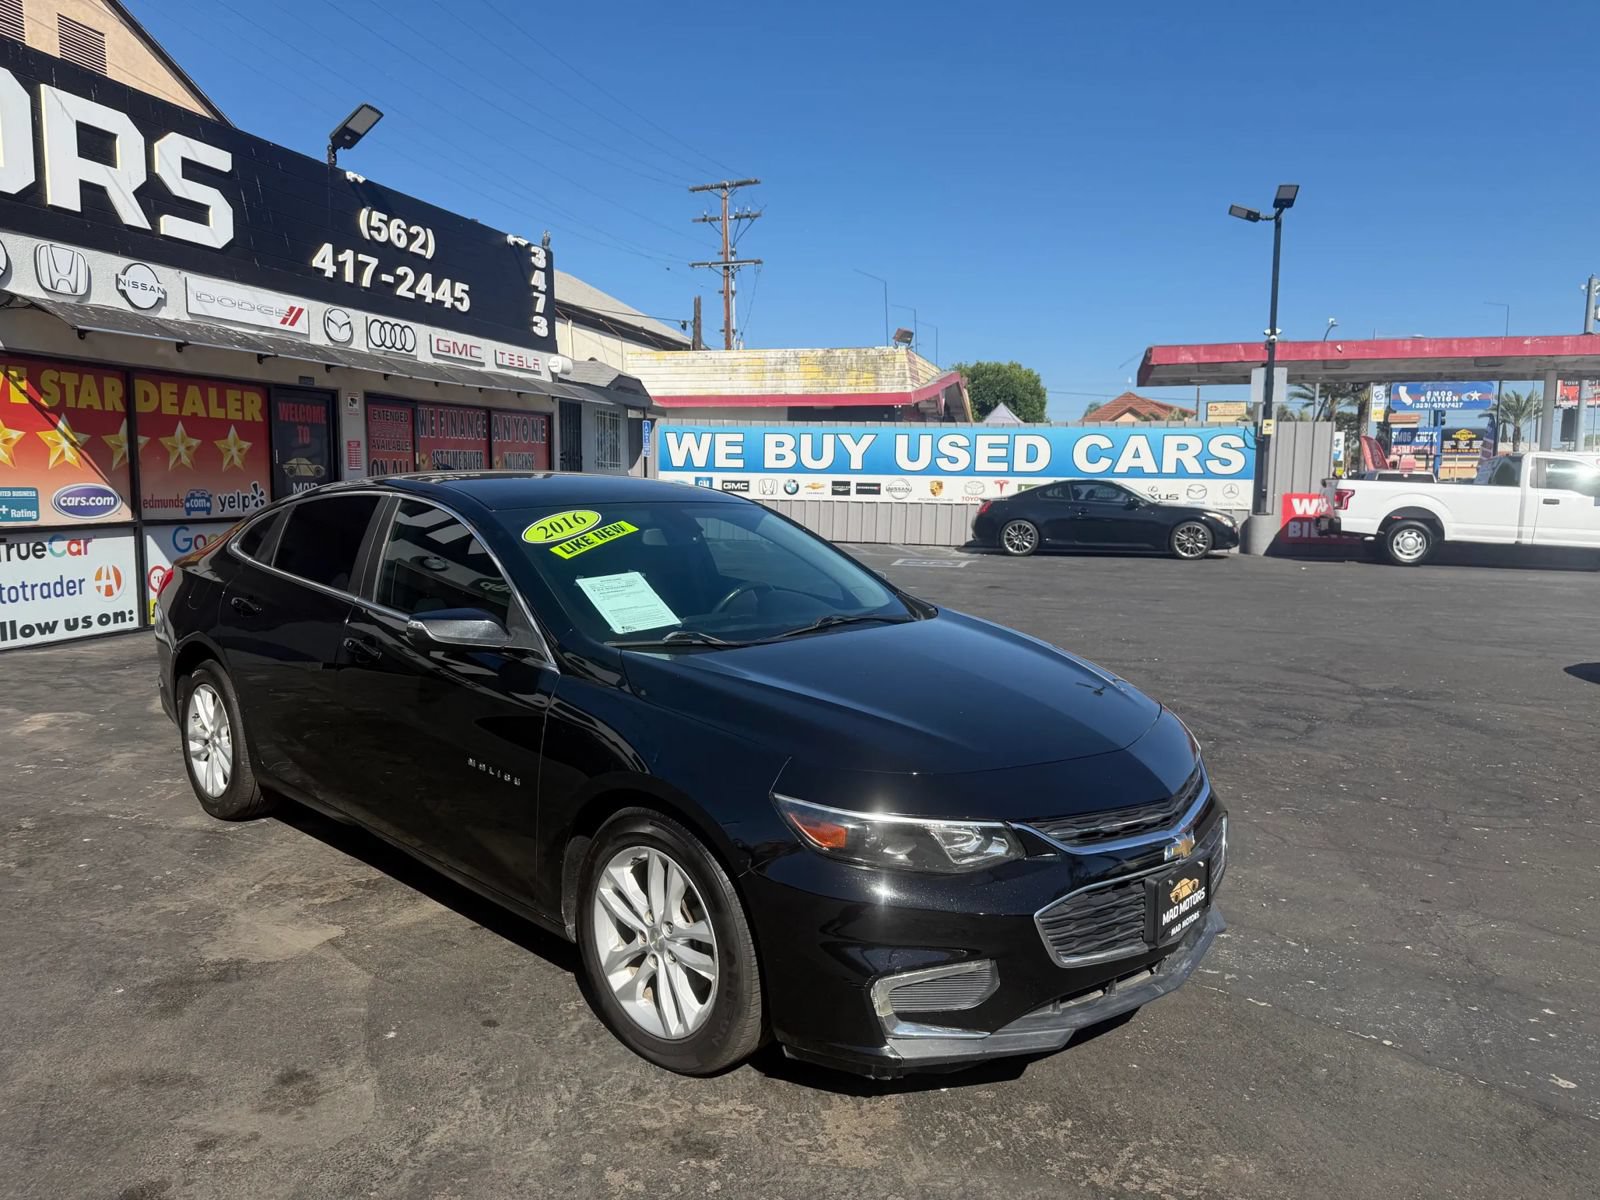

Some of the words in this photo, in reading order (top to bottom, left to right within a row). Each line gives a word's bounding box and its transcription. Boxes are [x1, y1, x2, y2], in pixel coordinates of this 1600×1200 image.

[358, 206, 436, 260] (562)
[118, 277, 166, 298] NISSAN
[311, 242, 471, 313] 417-2445
[530, 246, 549, 338] 3473
[196, 292, 290, 318] DODGE
[435, 338, 482, 359] GMC
[498, 351, 540, 371] TESLA
[40, 369, 126, 412] STAR
[134, 378, 264, 422] DEALER
[278, 402, 327, 424] WELCOME
[371, 408, 408, 423] EXTENDED
[418, 408, 436, 438] WE
[438, 409, 487, 440] FINANCE
[297, 425, 310, 444] TO
[493, 414, 546, 443] ANYONE
[665, 432, 745, 469] WE
[763, 432, 878, 470] BUY
[895, 433, 1051, 472] USED
[1072, 433, 1246, 476] CARS
[60, 495, 114, 507] cars.com
[143, 494, 184, 509] edmunds
[218, 491, 251, 513] yelp
[11, 508, 37, 519] Rating
[536, 512, 587, 539] 2016
[559, 536, 595, 555] LIKE
[595, 523, 626, 541] NEW
[64, 615, 93, 631] us
[97, 609, 134, 627] on:
[1162, 905, 1179, 926] MAD
[1179, 886, 1206, 915] MOTORS
